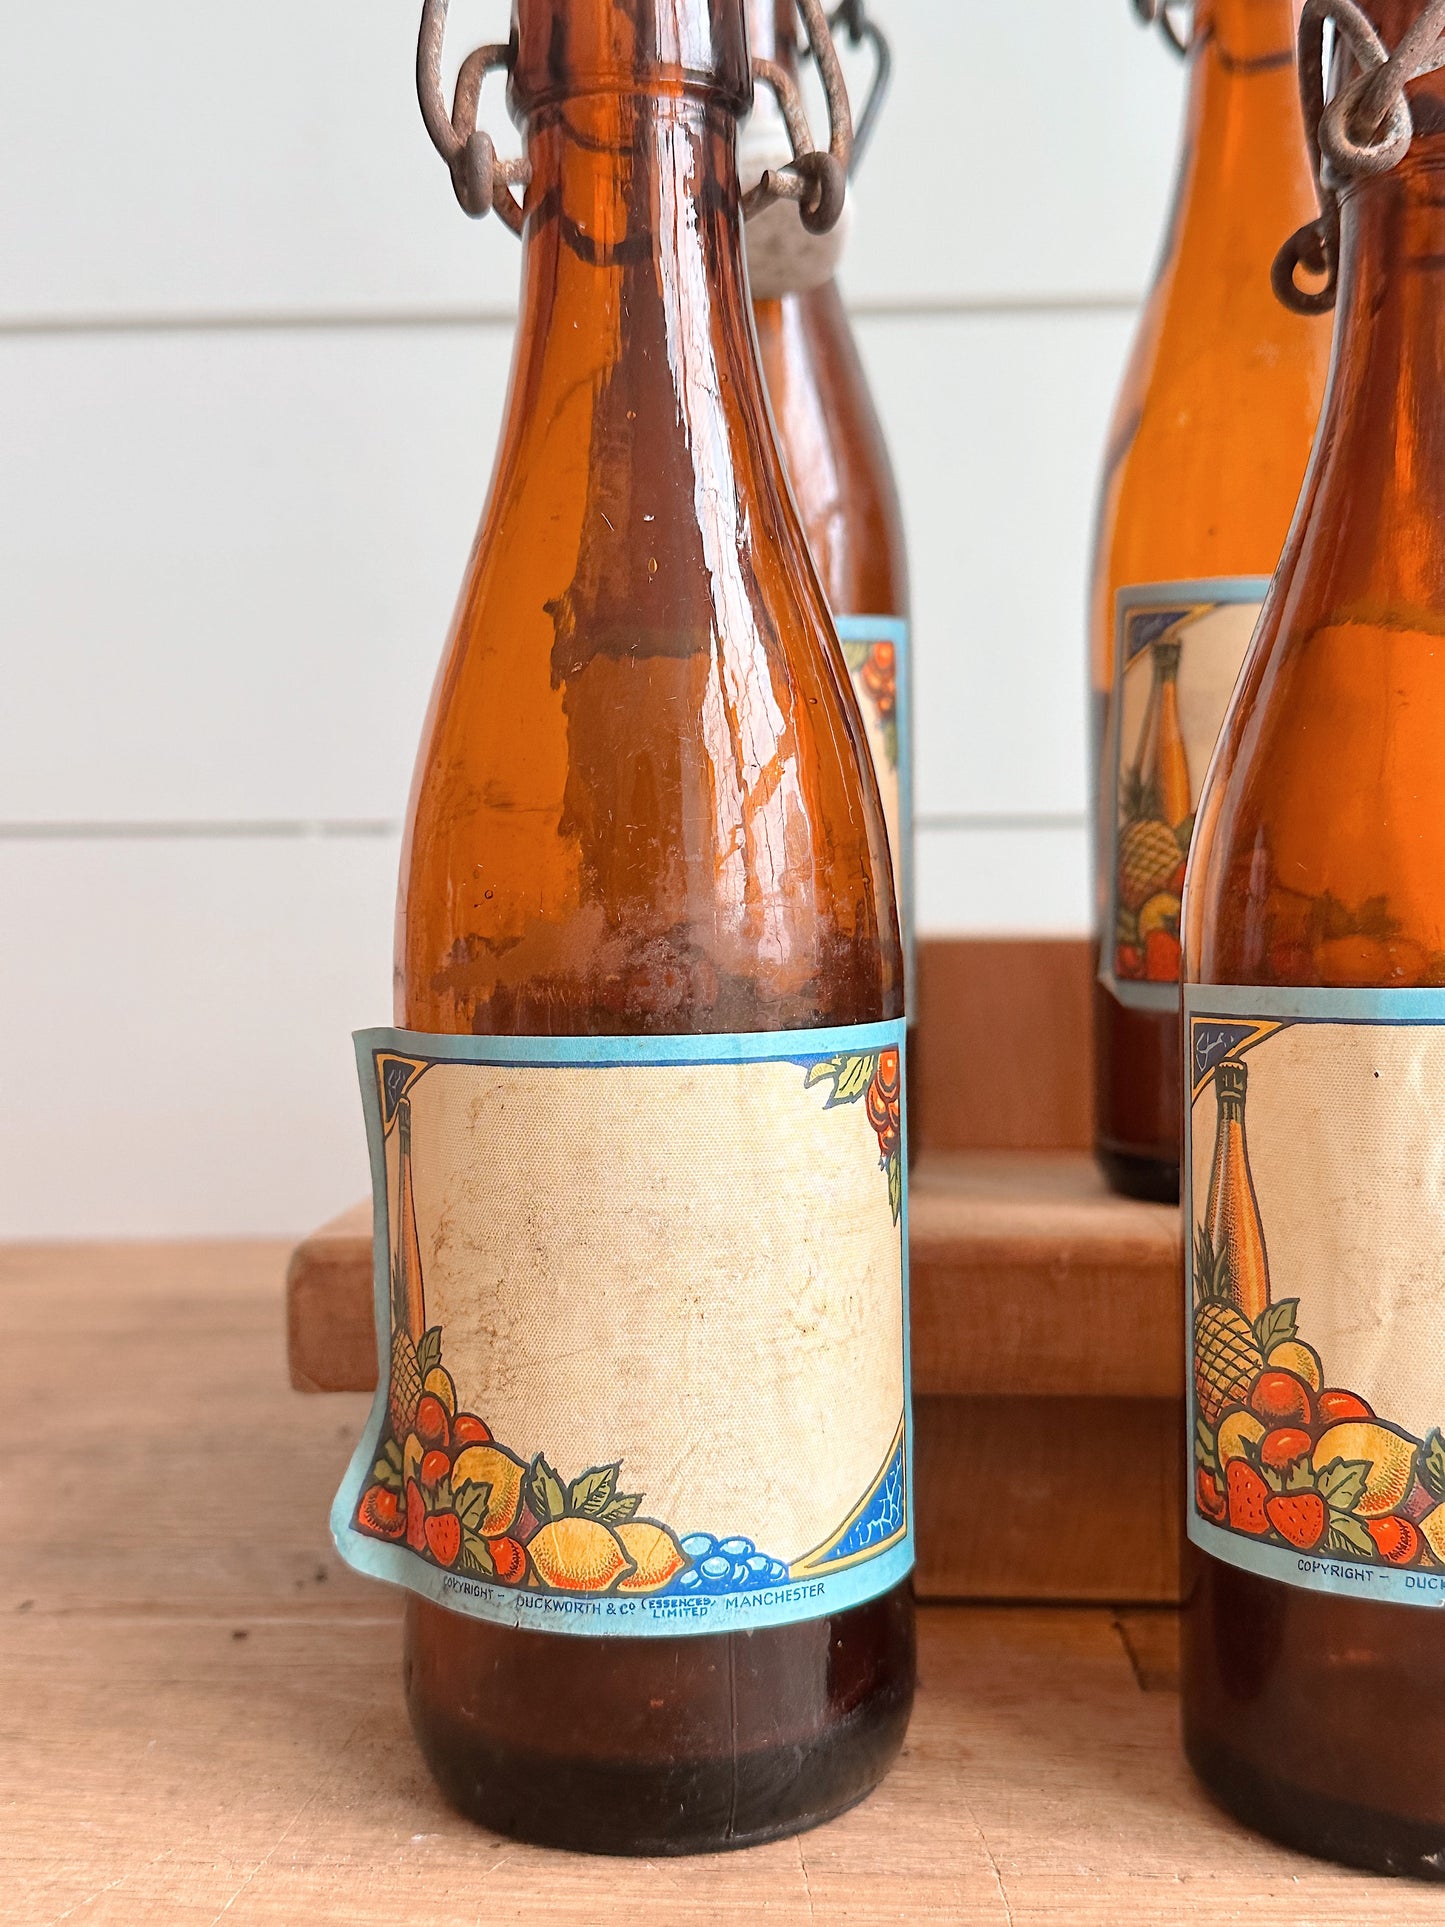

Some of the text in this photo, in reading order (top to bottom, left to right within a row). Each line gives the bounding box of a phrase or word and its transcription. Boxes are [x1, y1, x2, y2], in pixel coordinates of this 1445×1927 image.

[1297, 1558, 1374, 1582] COPYRIGHT
[443, 1575, 494, 1600] COPYRIGHT
[516, 1595, 601, 1615] DUCKWORTH
[606, 1602, 615, 1615] &
[725, 1582, 825, 1610] MANCHESTER
[653, 1607, 708, 1619] LIMITED
